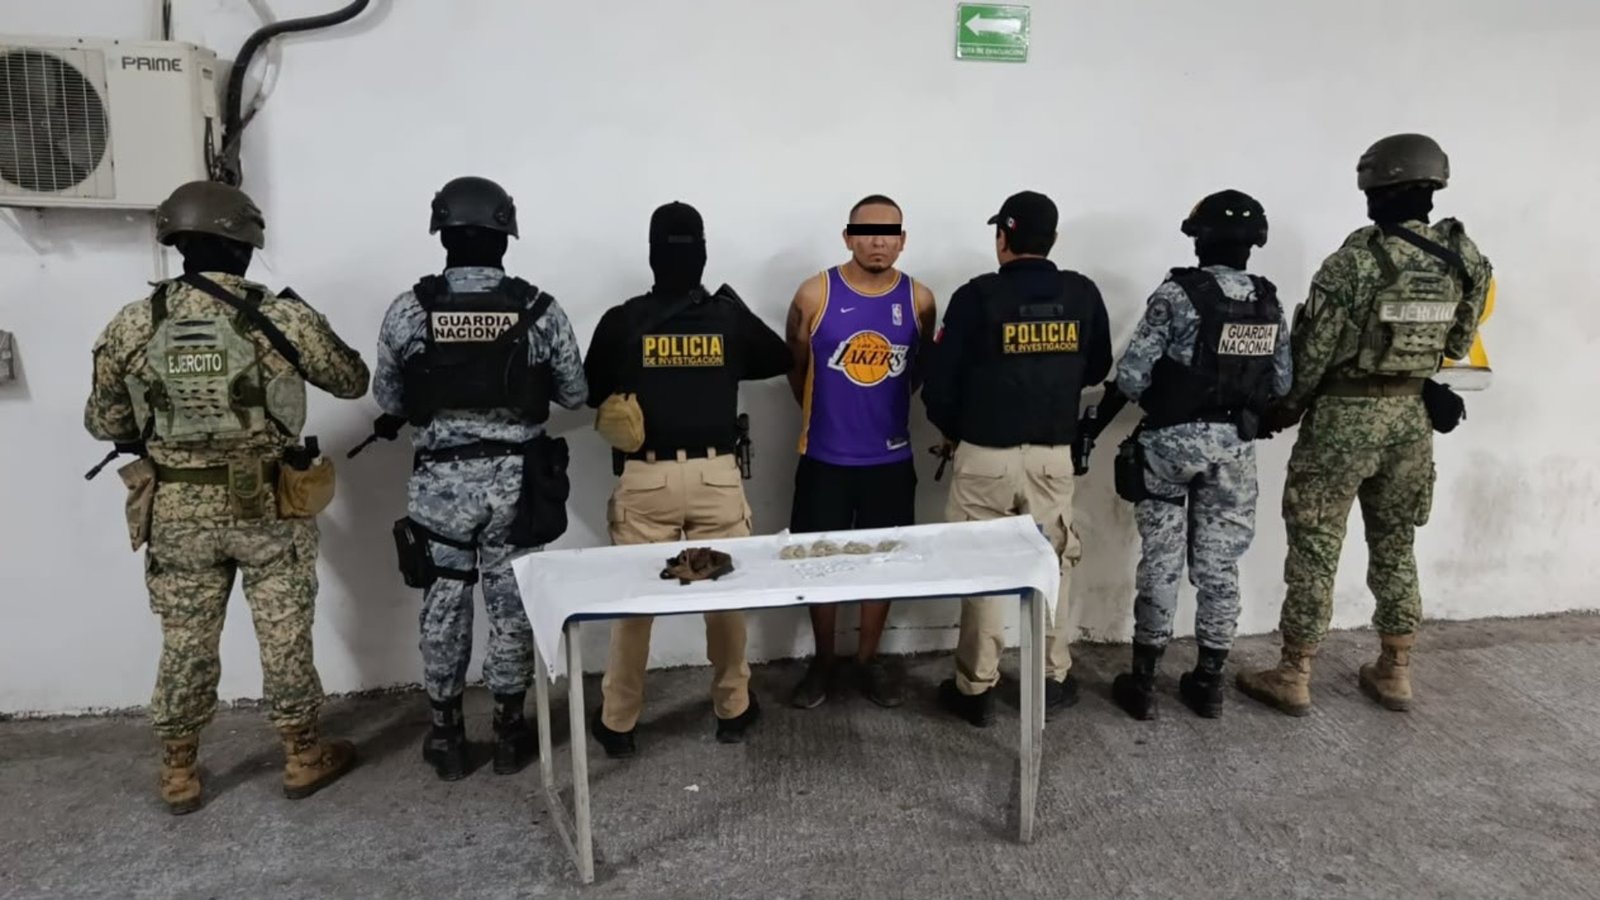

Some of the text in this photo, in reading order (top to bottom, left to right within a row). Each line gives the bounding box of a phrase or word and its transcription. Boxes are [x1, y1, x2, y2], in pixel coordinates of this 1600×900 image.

[121, 56, 183, 72] PRIME
[437, 315, 513, 327] GUARDIA
[434, 327, 508, 339] NACIONA
[1004, 322, 1077, 343] POLICIA
[1228, 325, 1273, 340] GUARDIA
[644, 336, 722, 357] POLICIA
[1004, 343, 1017, 353] DE
[1220, 339, 1273, 354] NACIONAL
[644, 356, 657, 366] DE
[830, 342, 906, 375] LAKERS
